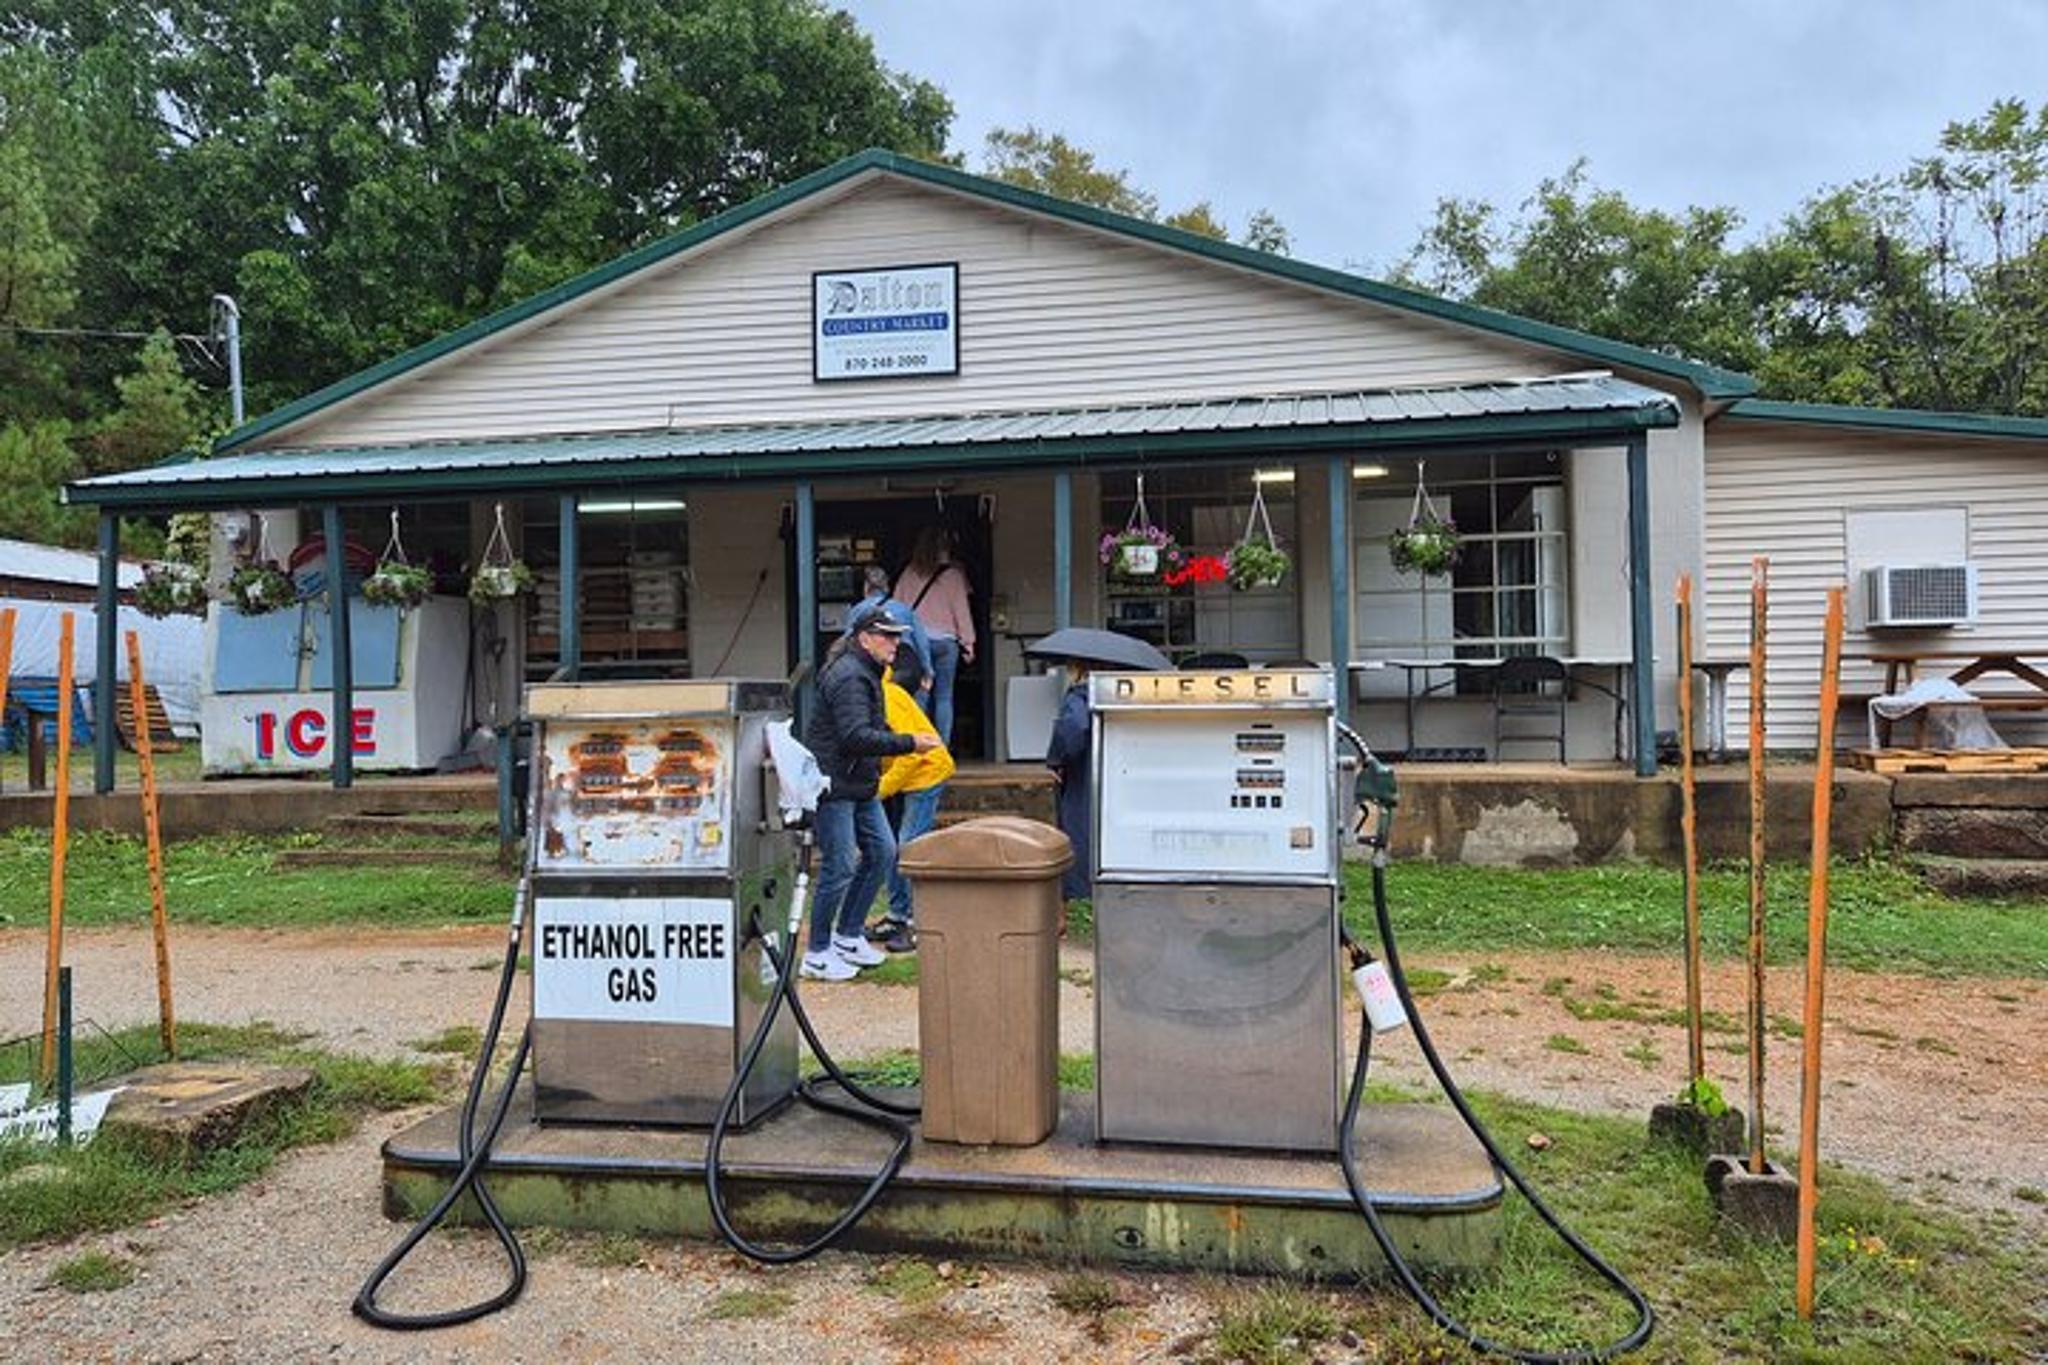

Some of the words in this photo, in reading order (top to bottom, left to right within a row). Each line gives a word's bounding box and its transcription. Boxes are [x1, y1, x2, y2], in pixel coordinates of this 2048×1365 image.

[828, 276, 943, 314] Dalton
[825, 320, 887, 334] COUNTRY
[892, 315, 944, 329] MARKET
[1115, 676, 1309, 698] DIESEL
[256, 708, 376, 760] ICE
[542, 925, 656, 959] ETHANOL
[664, 924, 725, 959] FREE
[607, 968, 657, 1002] GAS
